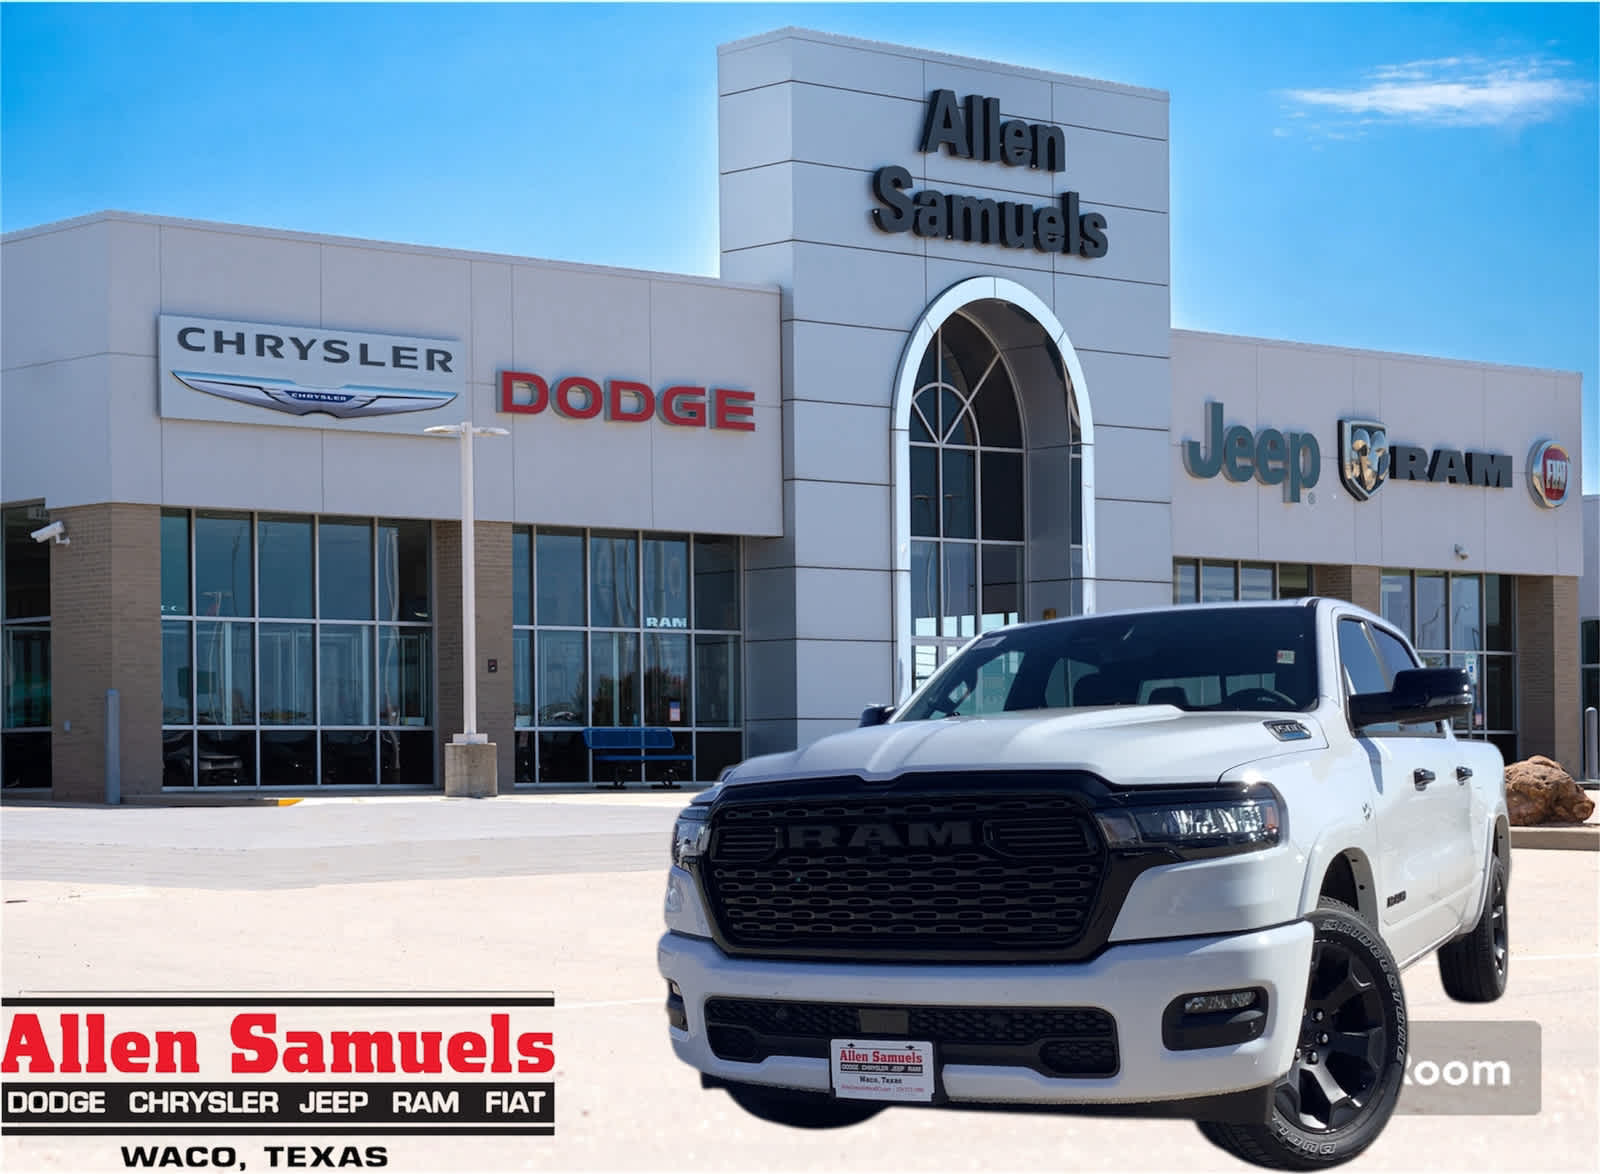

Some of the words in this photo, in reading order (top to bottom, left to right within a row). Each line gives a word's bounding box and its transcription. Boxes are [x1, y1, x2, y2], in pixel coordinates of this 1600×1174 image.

[919, 89, 1066, 172] Allen
[872, 165, 1108, 258] Samuels
[177, 327, 453, 373] CHRYSLER
[291, 392, 347, 401] CHRYSLER
[496, 370, 755, 432] DODGE
[1183, 401, 1320, 503] Jeep
[1389, 445, 1513, 488] RAM
[1546, 459, 1567, 489] FIAT
[646, 616, 687, 628] RAM
[788, 820, 974, 849] RAM
[840, 1049, 868, 1062] Allen
[872, 1051, 922, 1064] Samuels
